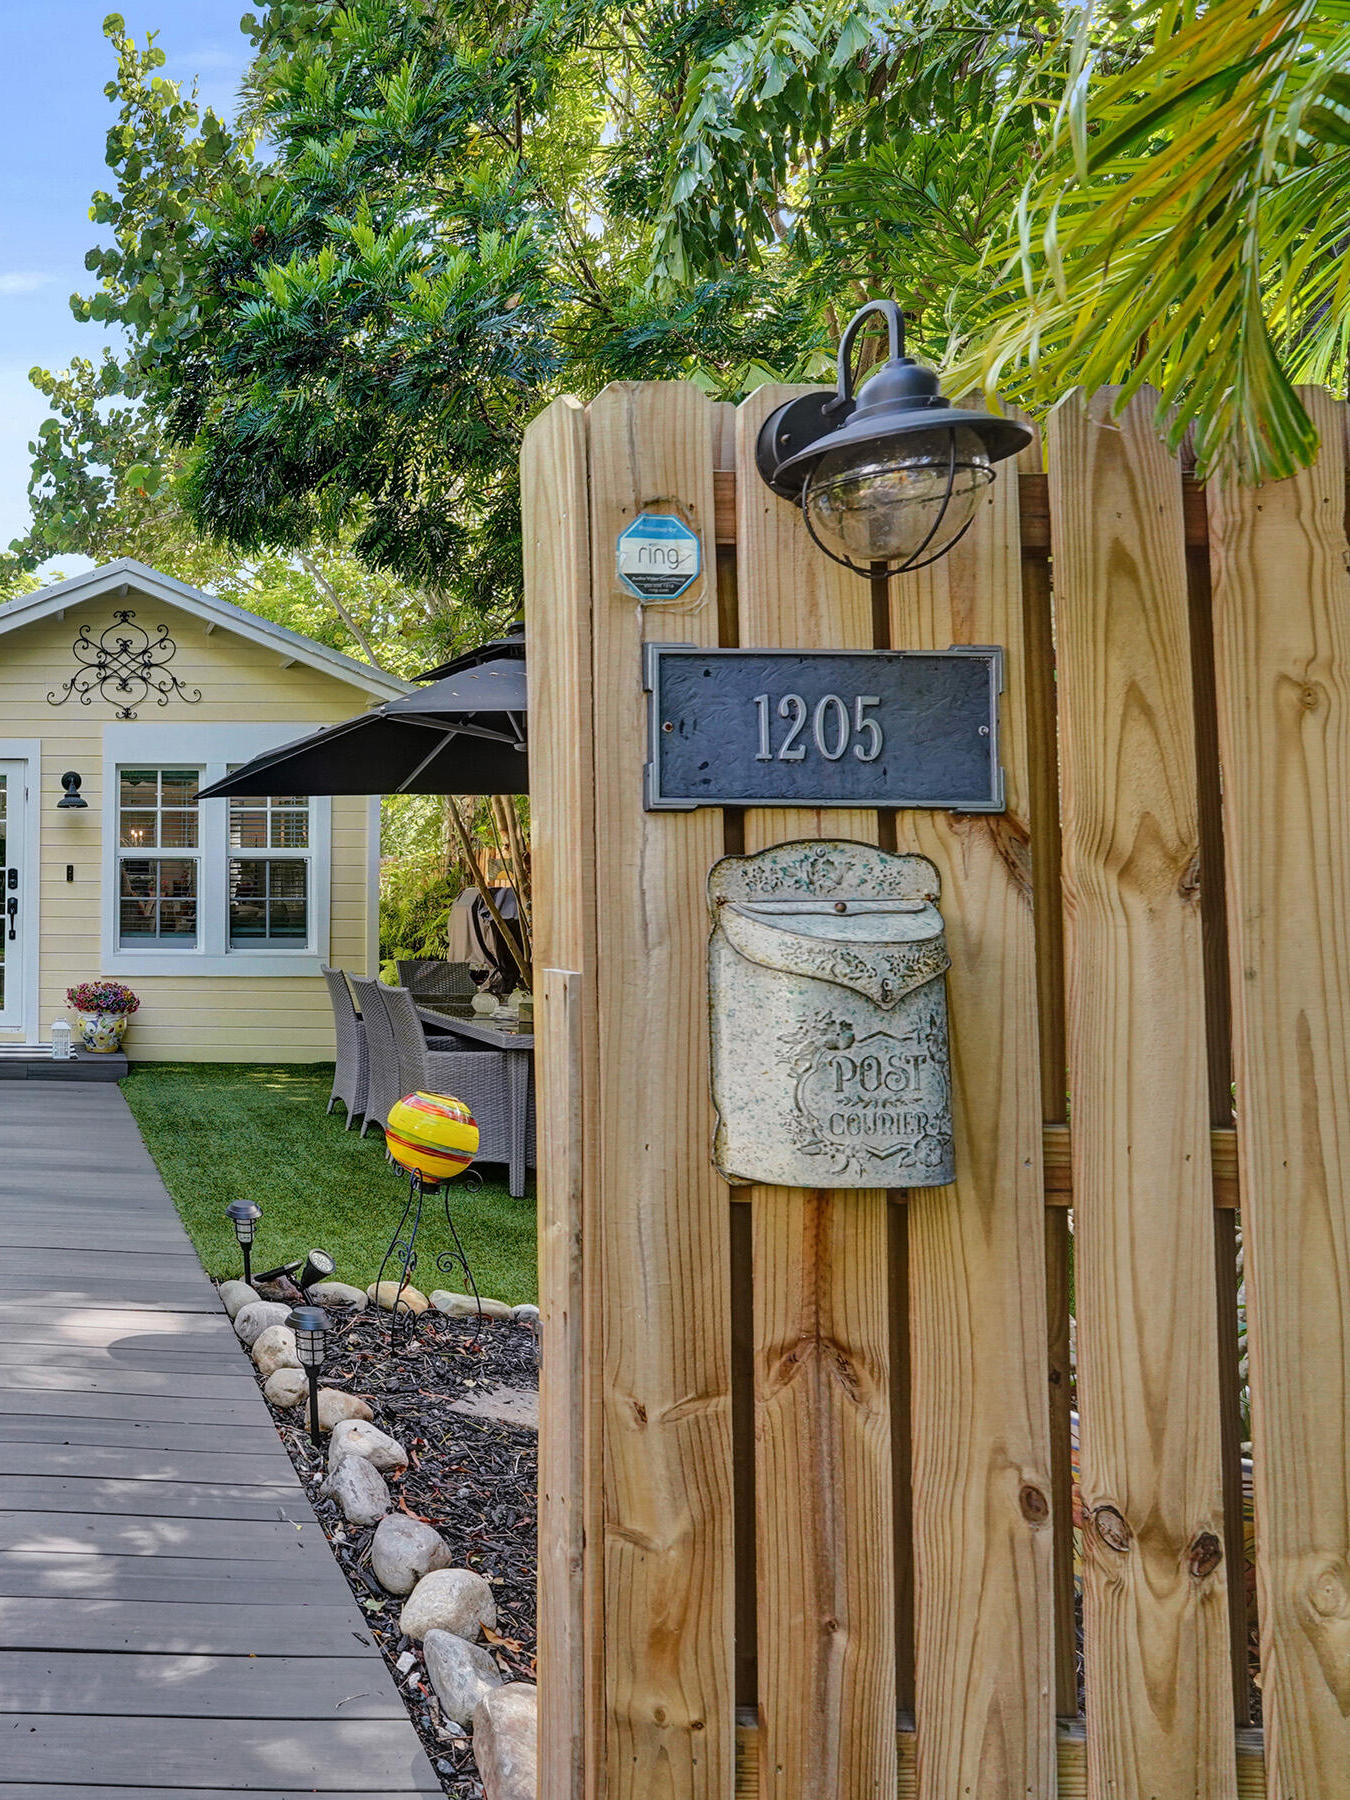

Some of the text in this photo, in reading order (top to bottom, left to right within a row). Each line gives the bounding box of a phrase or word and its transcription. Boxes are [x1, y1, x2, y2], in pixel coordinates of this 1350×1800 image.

[638, 544, 679, 570] ring
[753, 693, 883, 762] 1205
[829, 1054, 927, 1093] POST
[830, 1111, 929, 1136] COURIER
